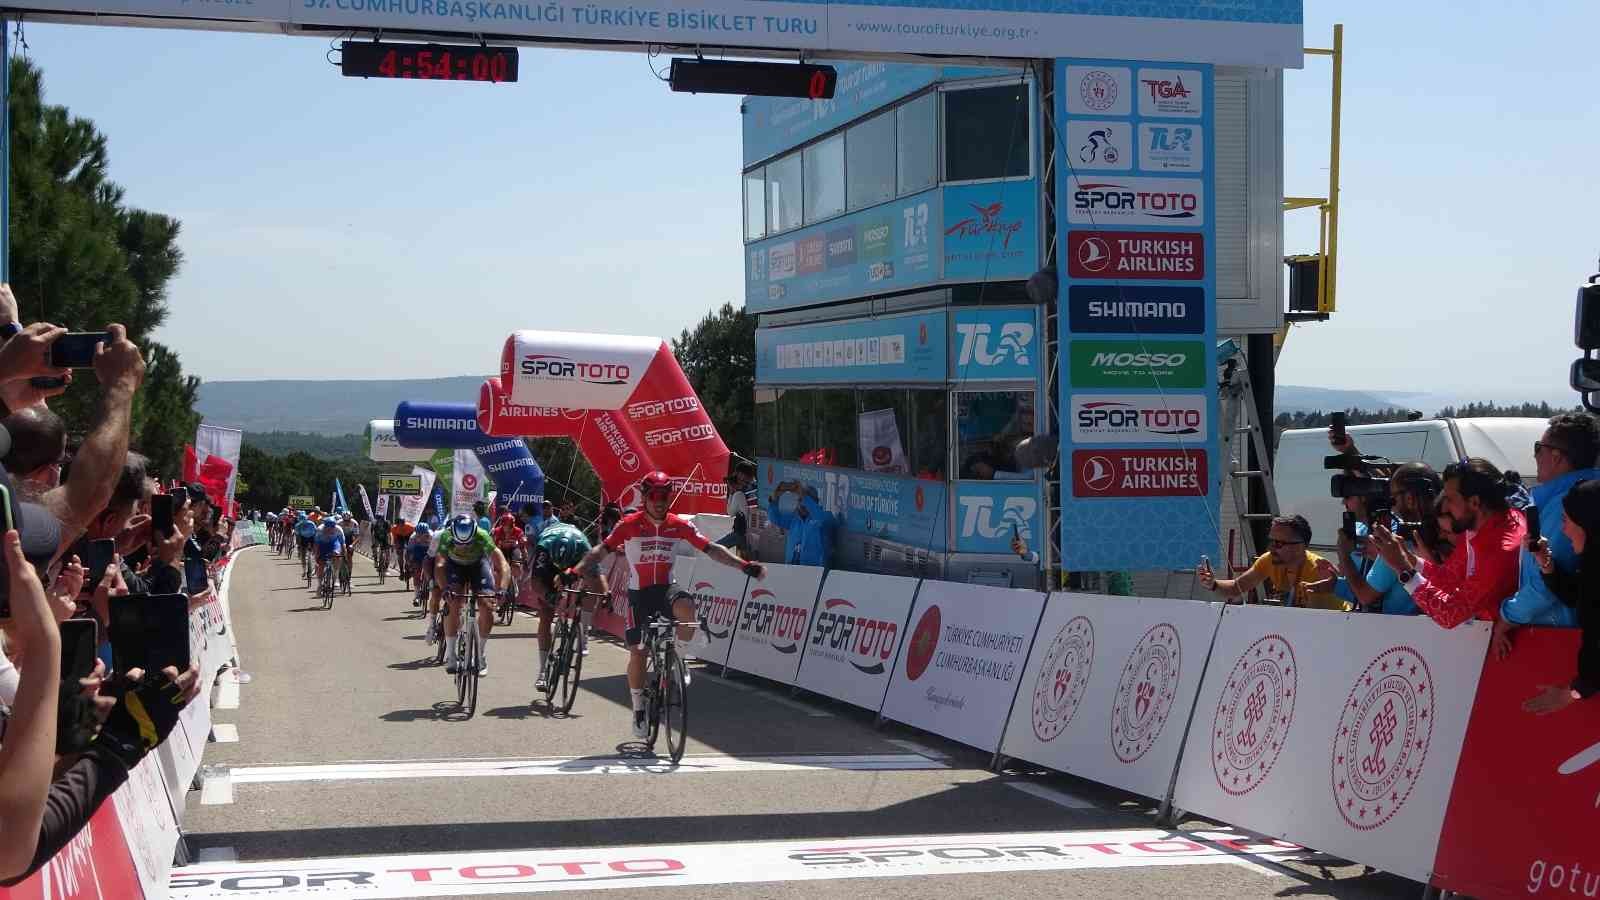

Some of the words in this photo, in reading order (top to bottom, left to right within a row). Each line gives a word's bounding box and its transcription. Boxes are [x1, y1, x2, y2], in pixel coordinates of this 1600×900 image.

[572, 4, 659, 27] TÜRKİYE
[667, 10, 756, 31] BİSİKLET
[763, 16, 818, 34] TURU
[855, 22, 1031, 40] www.tourofturkiye.org.tr
[379, 49, 507, 82] 4:54:00
[808, 70, 827, 98] 0
[1141, 75, 1192, 104] TGA
[1074, 191, 1197, 211] SPORTOTO
[1118, 239, 1193, 255] TURKISH
[1117, 257, 1195, 272] AIRLINES
[1088, 301, 1186, 318] SHIMANO
[1091, 352, 1187, 367] MOSSO
[521, 360, 630, 380] SPORTOTO
[498, 407, 559, 417] AIRLINES
[628, 396, 698, 419] SPORTOTO
[407, 417, 477, 430] SHIMANO
[1078, 410, 1200, 428] SPORTOTO
[601, 410, 630, 451] TURKISH
[645, 424, 714, 447] SPORTOTO
[488, 457, 535, 473] SHIMANO
[1121, 457, 1197, 472] TURKISH
[388, 479, 403, 488] 50
[1121, 474, 1199, 489] AIRLINES
[741, 601, 808, 641] SPORTOTO
[812, 611, 898, 660] SPORTOTO
[943, 625, 973, 646] TÜRKİYE
[972, 629, 1023, 653] CUMHURİYETİ
[935, 650, 1015, 681] CUMHURBAŞKANLIĞI
[1527, 859, 1600, 897] gotu
